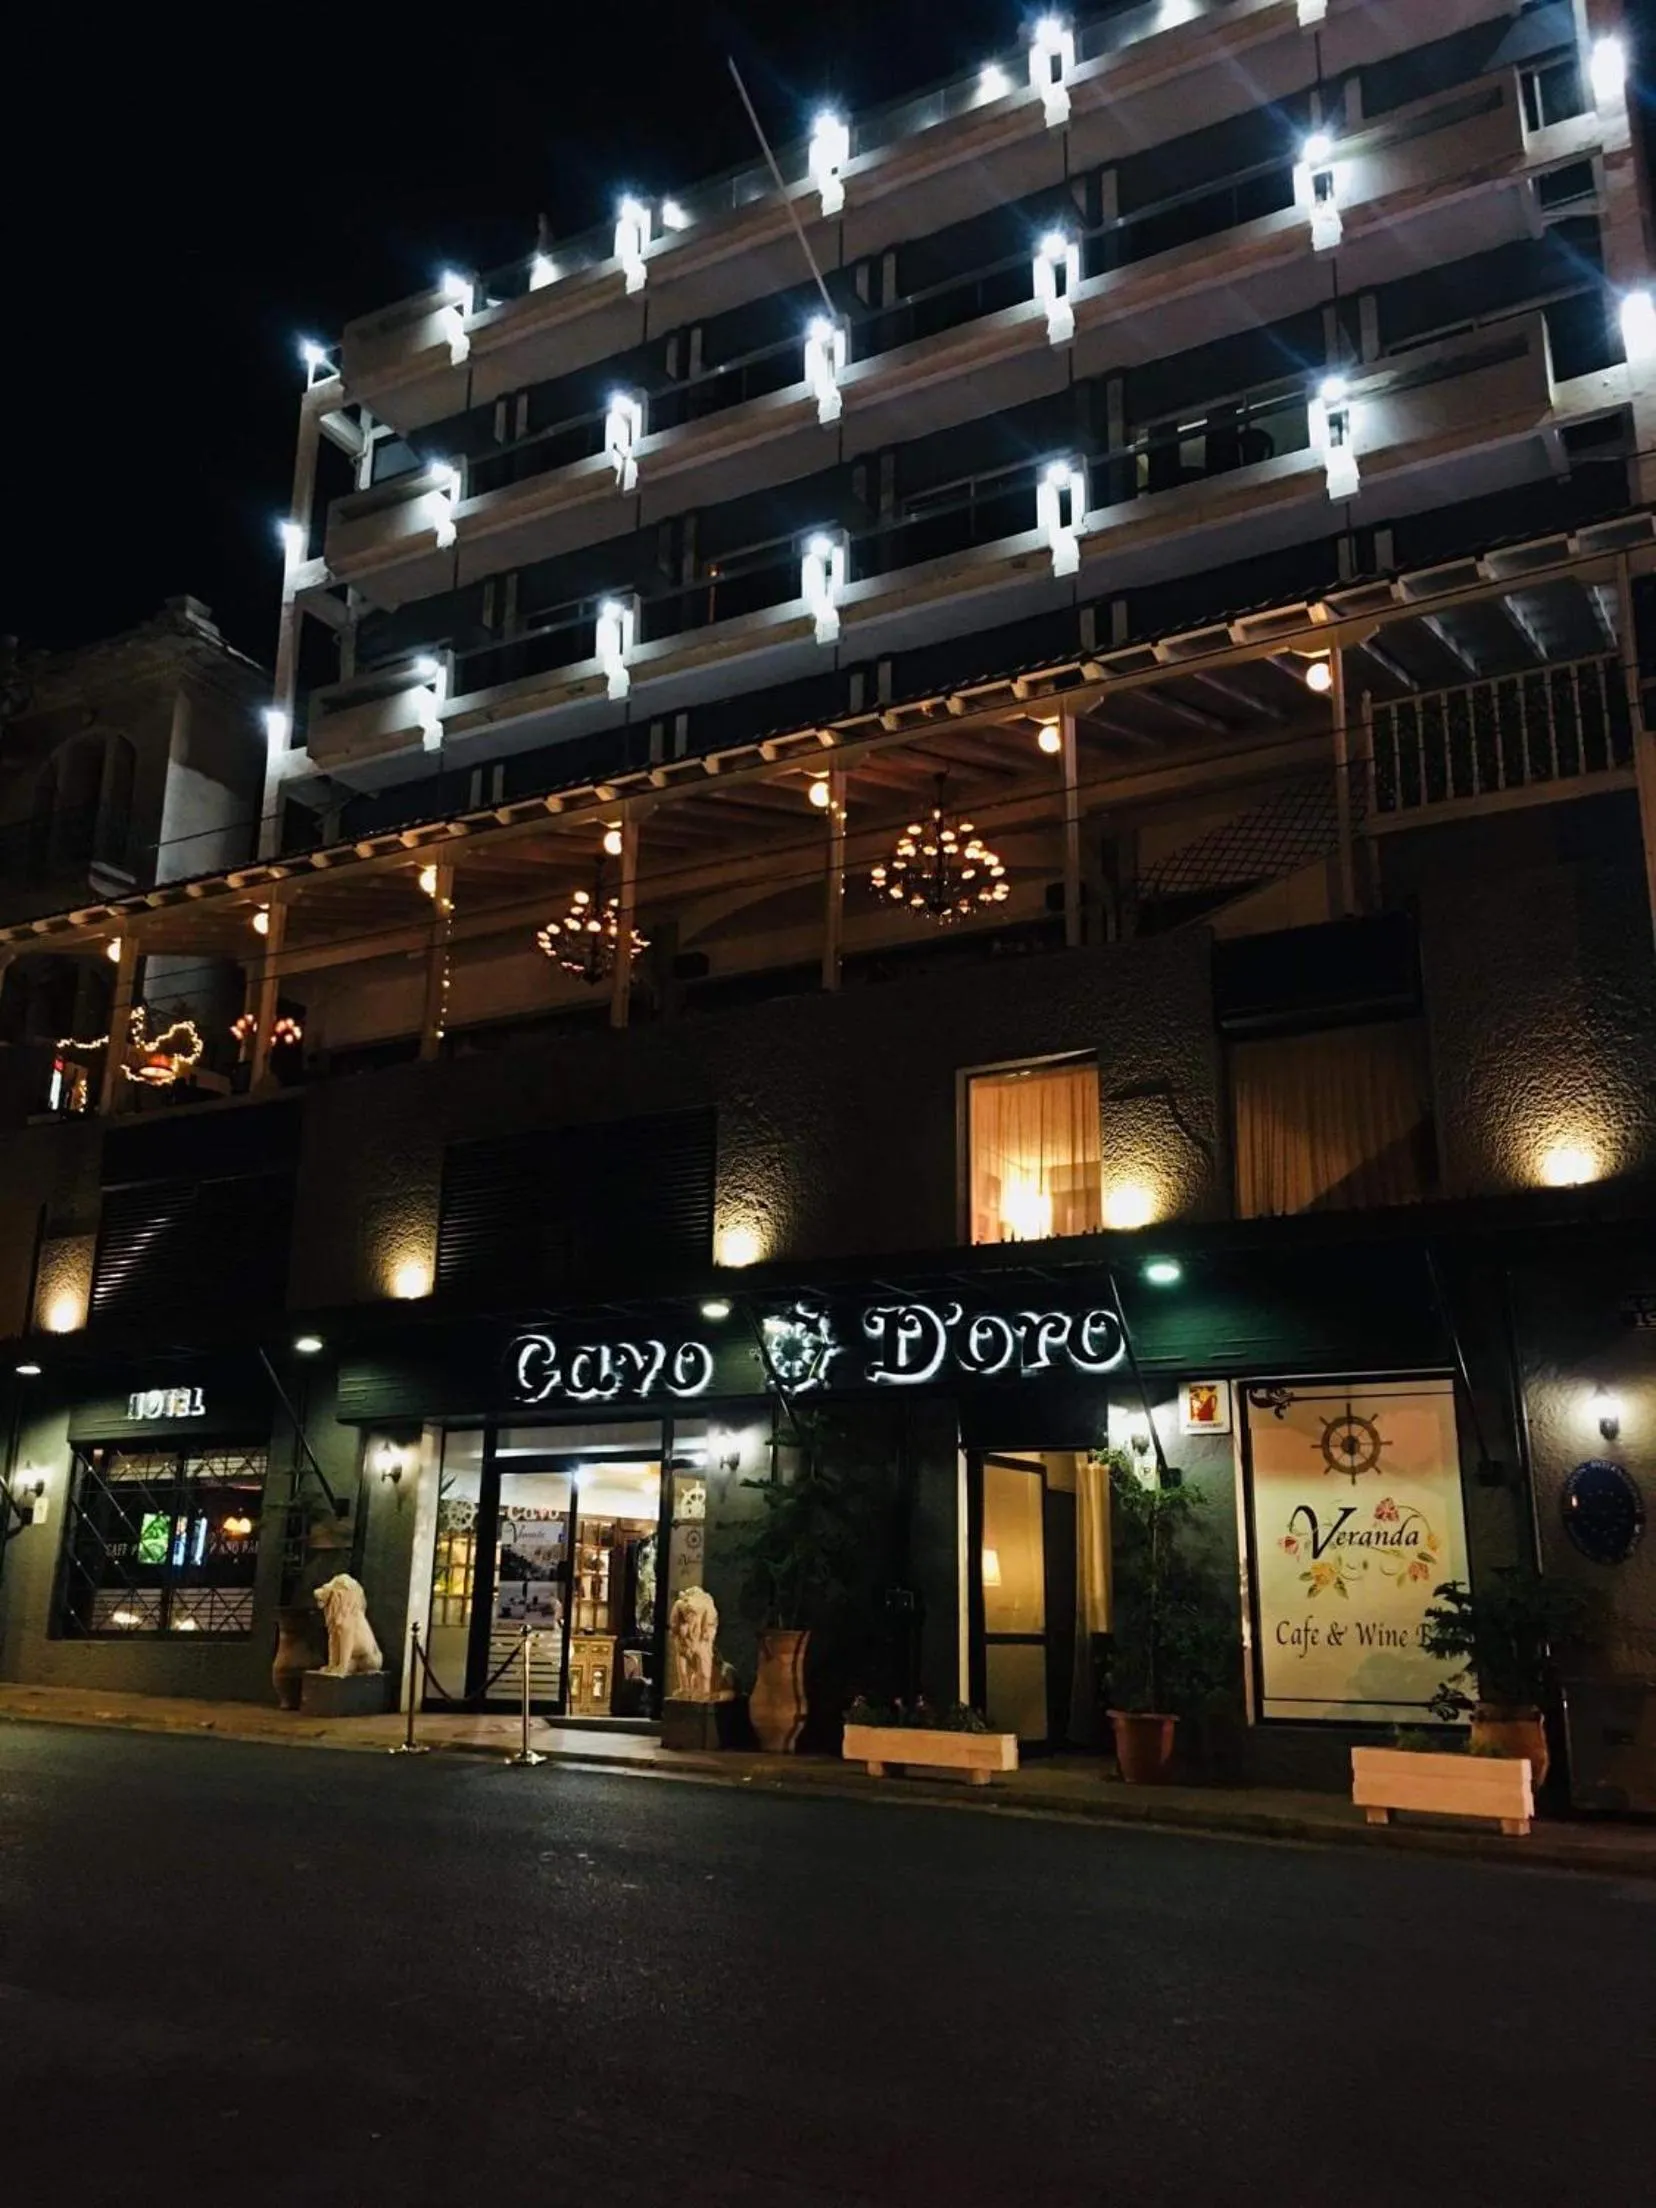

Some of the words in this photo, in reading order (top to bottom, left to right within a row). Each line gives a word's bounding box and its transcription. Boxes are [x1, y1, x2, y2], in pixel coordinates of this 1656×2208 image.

[510, 1333, 714, 1402] Cavo
[1288, 1504, 1421, 1559] Veranda
[1276, 1614, 1320, 1658] Cafe
[1327, 1620, 1348, 1646] &
[1355, 1620, 1408, 1647] Wine
